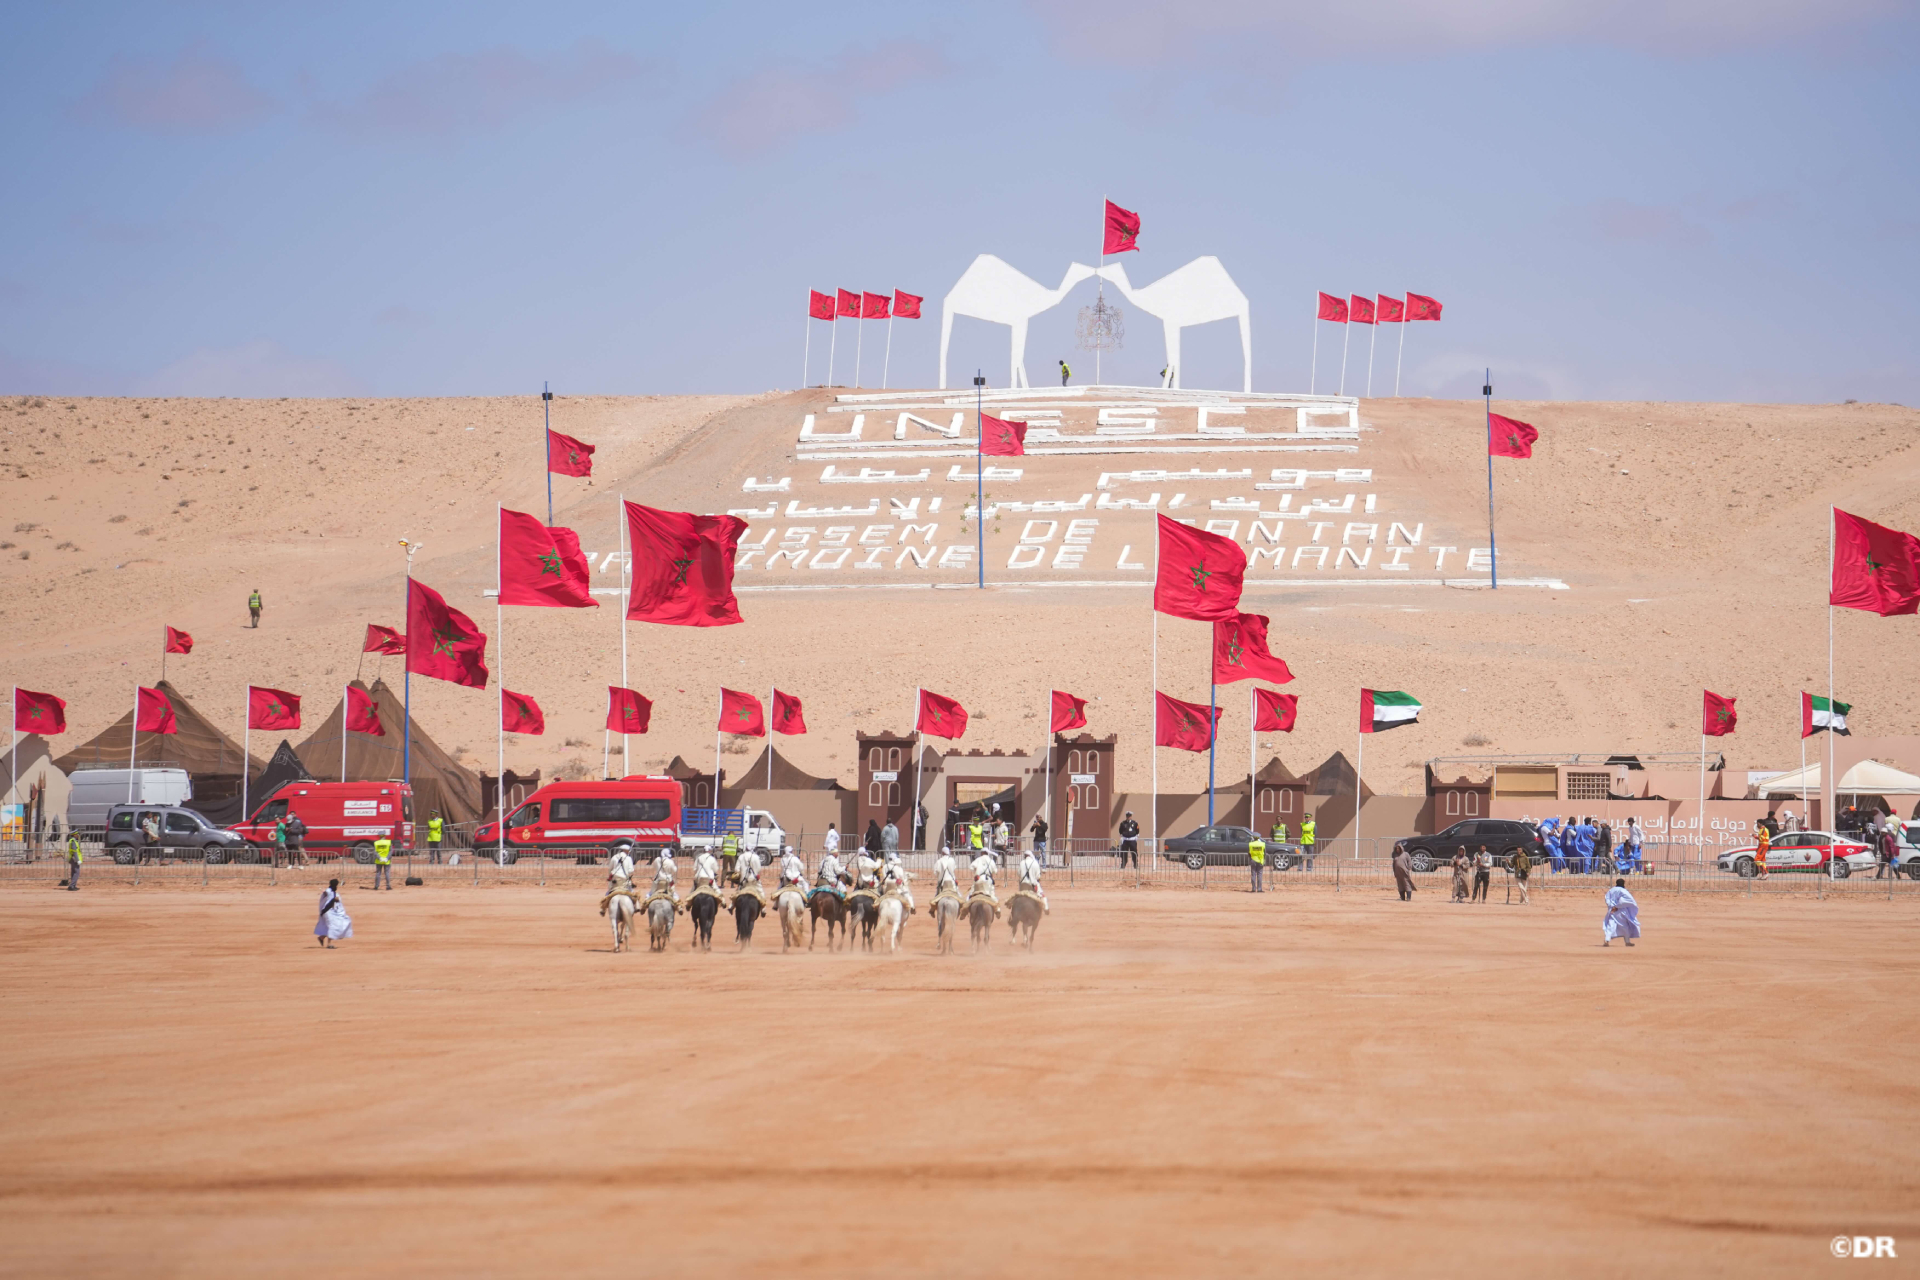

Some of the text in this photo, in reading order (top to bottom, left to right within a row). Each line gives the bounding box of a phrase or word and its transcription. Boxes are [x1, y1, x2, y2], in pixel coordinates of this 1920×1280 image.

[799, 405, 1359, 442] UNESCO
[737, 523, 939, 550] USSEM
[1019, 518, 1100, 544] DE
[1307, 520, 1424, 545] TAN
[584, 546, 976, 573] AIMOINE
[1006, 545, 1088, 569] DE
[1710, 817, 1746, 833] دولة
[1717, 831, 1759, 847] Pavi
